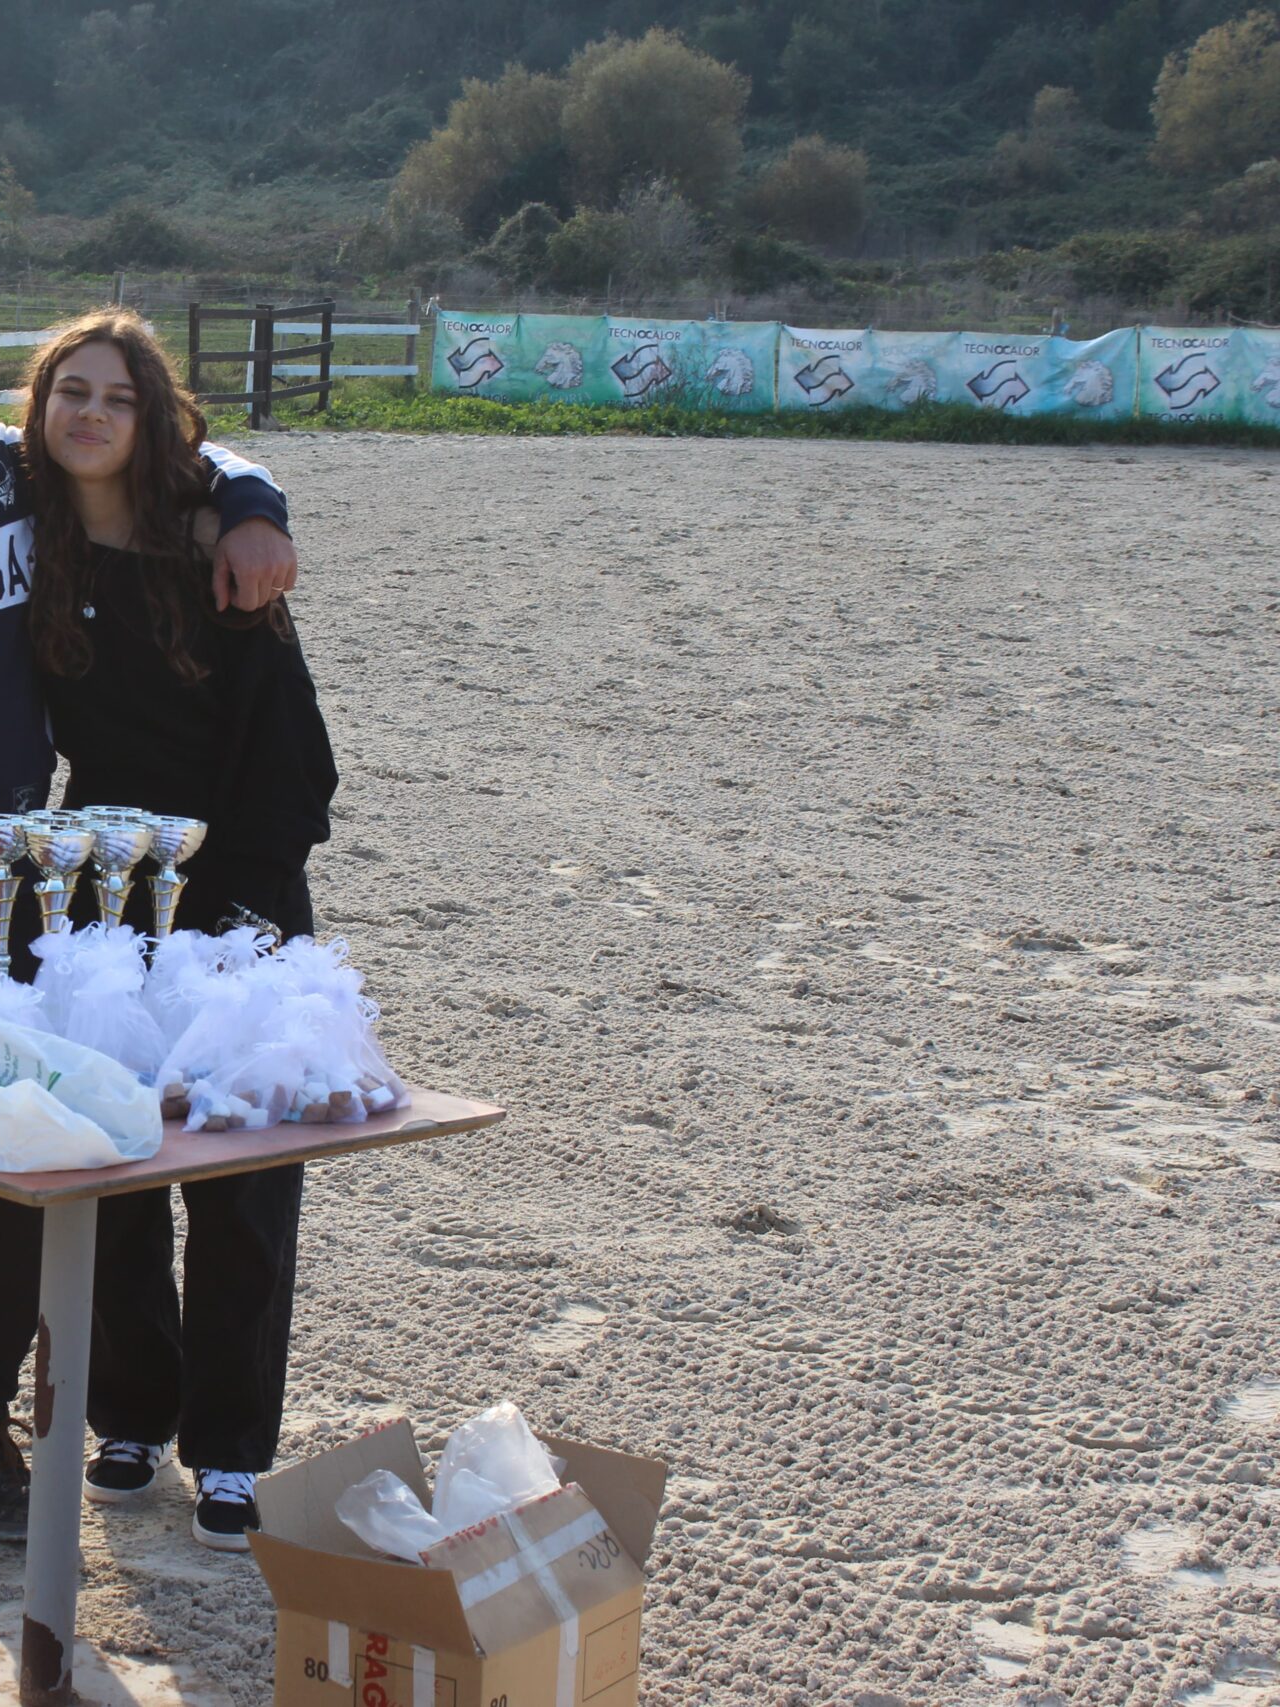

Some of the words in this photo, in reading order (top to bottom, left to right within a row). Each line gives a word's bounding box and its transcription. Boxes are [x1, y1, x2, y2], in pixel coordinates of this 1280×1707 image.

[442, 320, 512, 334] TECNOCALOR
[609, 327, 681, 341] TECNOCALOR
[791, 337, 863, 351] TECNOCALOR
[964, 343, 1040, 356] TECNOCALOR
[1151, 338, 1230, 348] TECNOCALOR
[304, 1657, 329, 1682] 80
